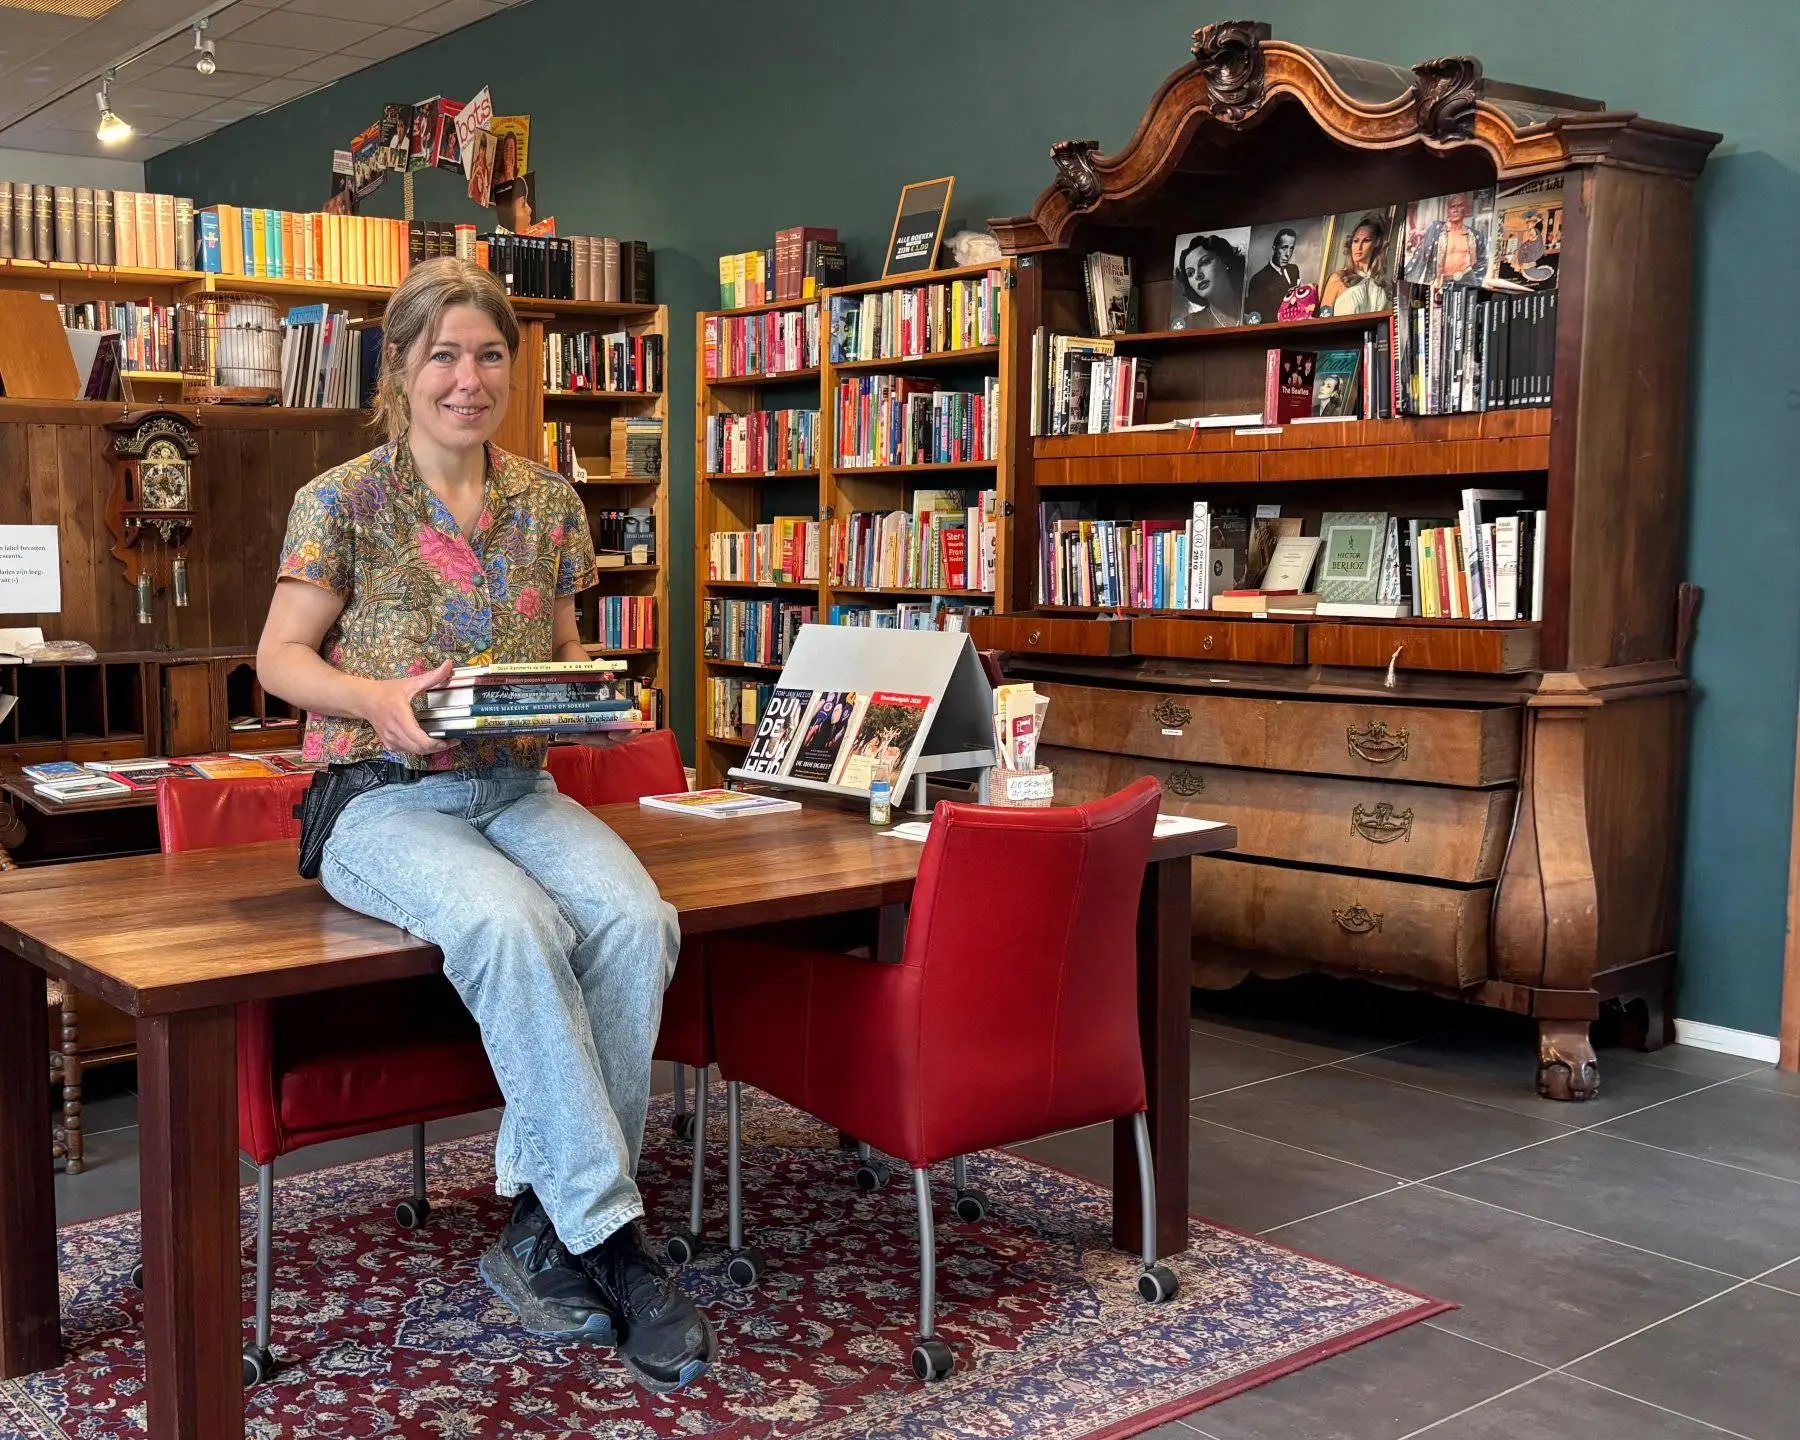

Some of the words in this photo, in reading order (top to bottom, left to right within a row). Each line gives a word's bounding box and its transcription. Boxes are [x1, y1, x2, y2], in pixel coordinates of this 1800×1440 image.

[456, 97, 492, 143] bots
[897, 236, 909, 244] ALLE
[911, 232, 934, 241] BOEKEN
[1291, 387, 1309, 395] Beatles
[1332, 561, 1364, 572] BERLIOZ
[759, 717, 785, 738] DE
[750, 738, 790, 759] LIJK
[745, 758, 780, 775] HEID
